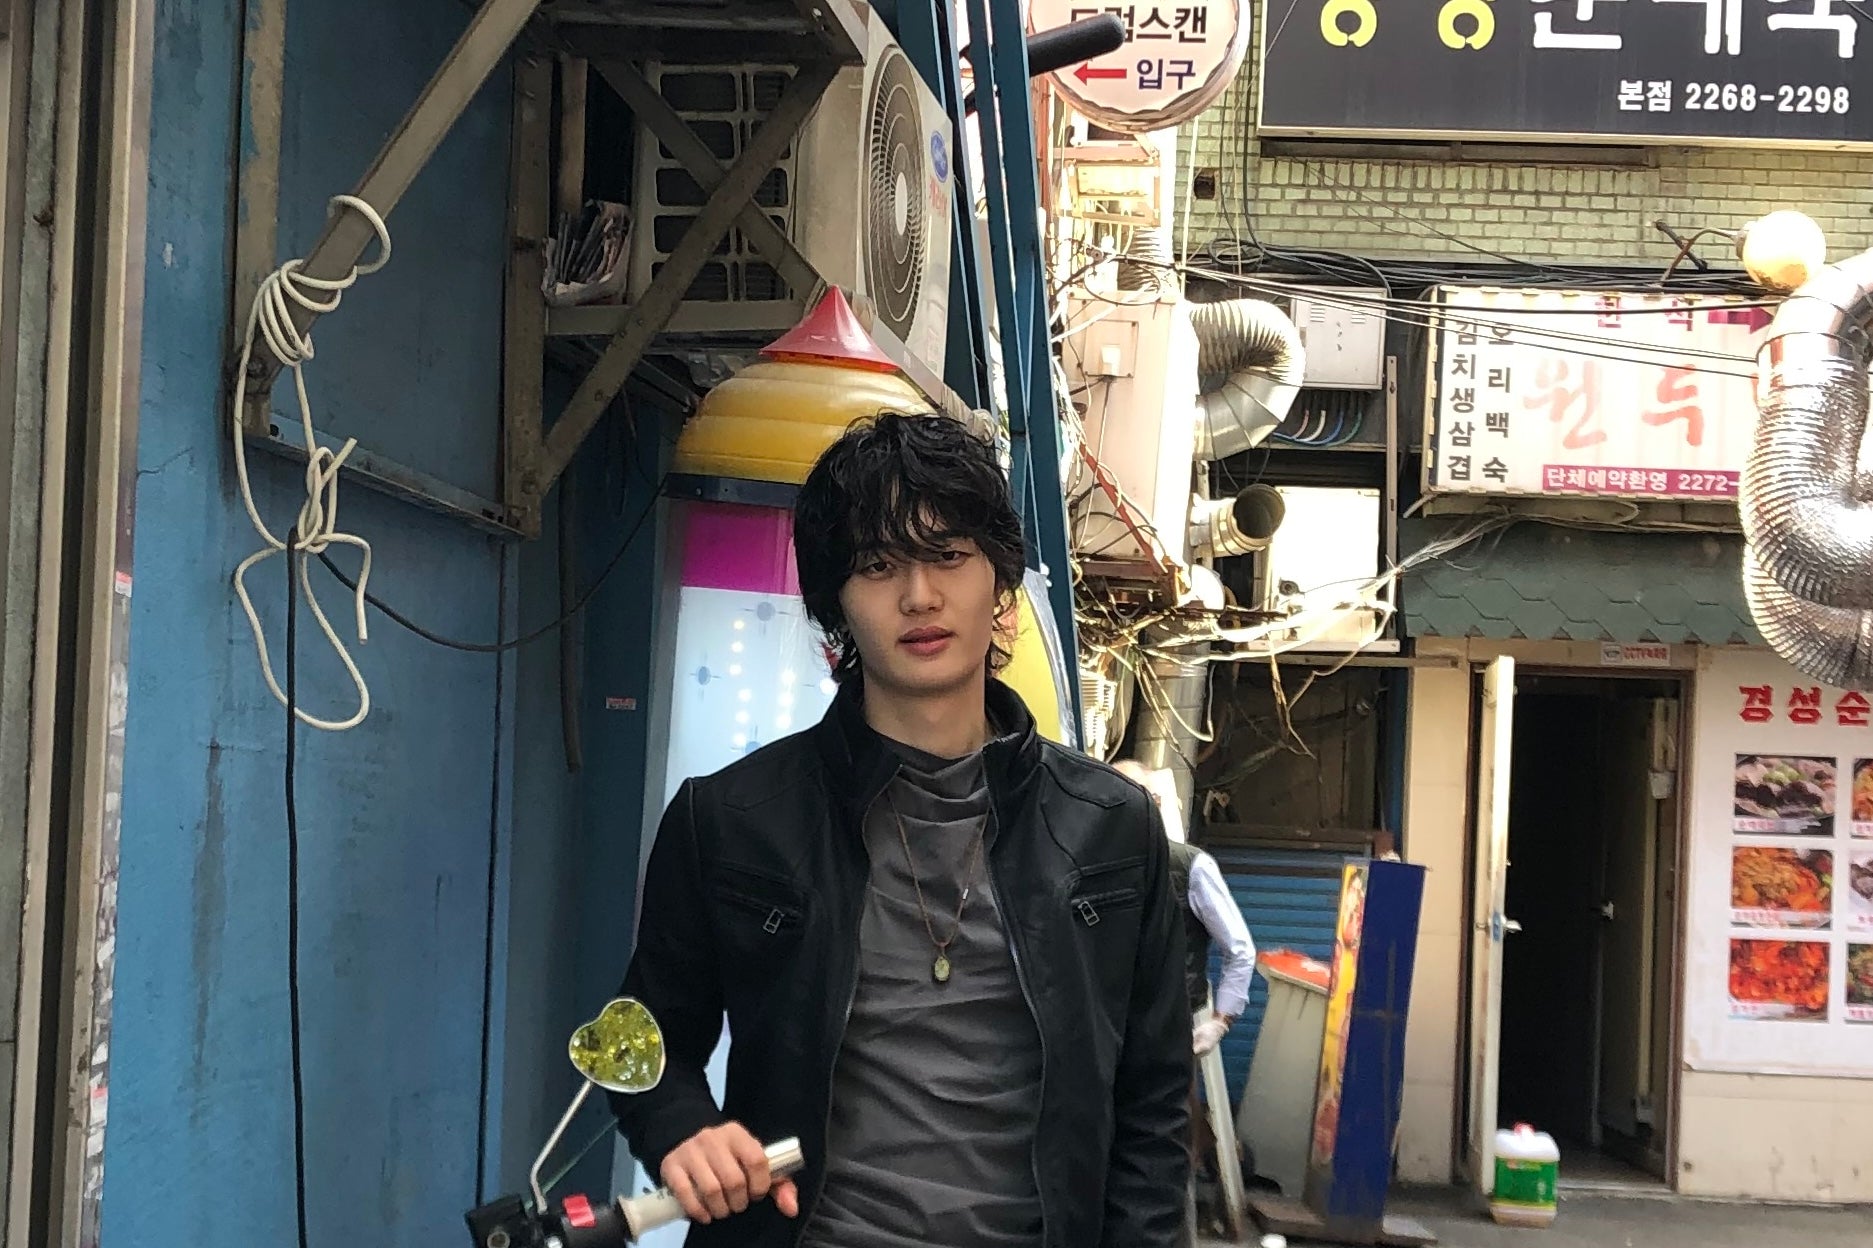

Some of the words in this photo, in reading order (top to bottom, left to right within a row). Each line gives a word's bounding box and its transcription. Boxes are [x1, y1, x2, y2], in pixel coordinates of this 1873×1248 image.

[1136, 58, 1196, 90] 입구
[1618, 80, 1672, 112] 본점
[1685, 83, 1850, 114] 2268-2298
[1547, 468, 1668, 491] 단체예약환영
[1738, 685, 1872, 728] 경성순
